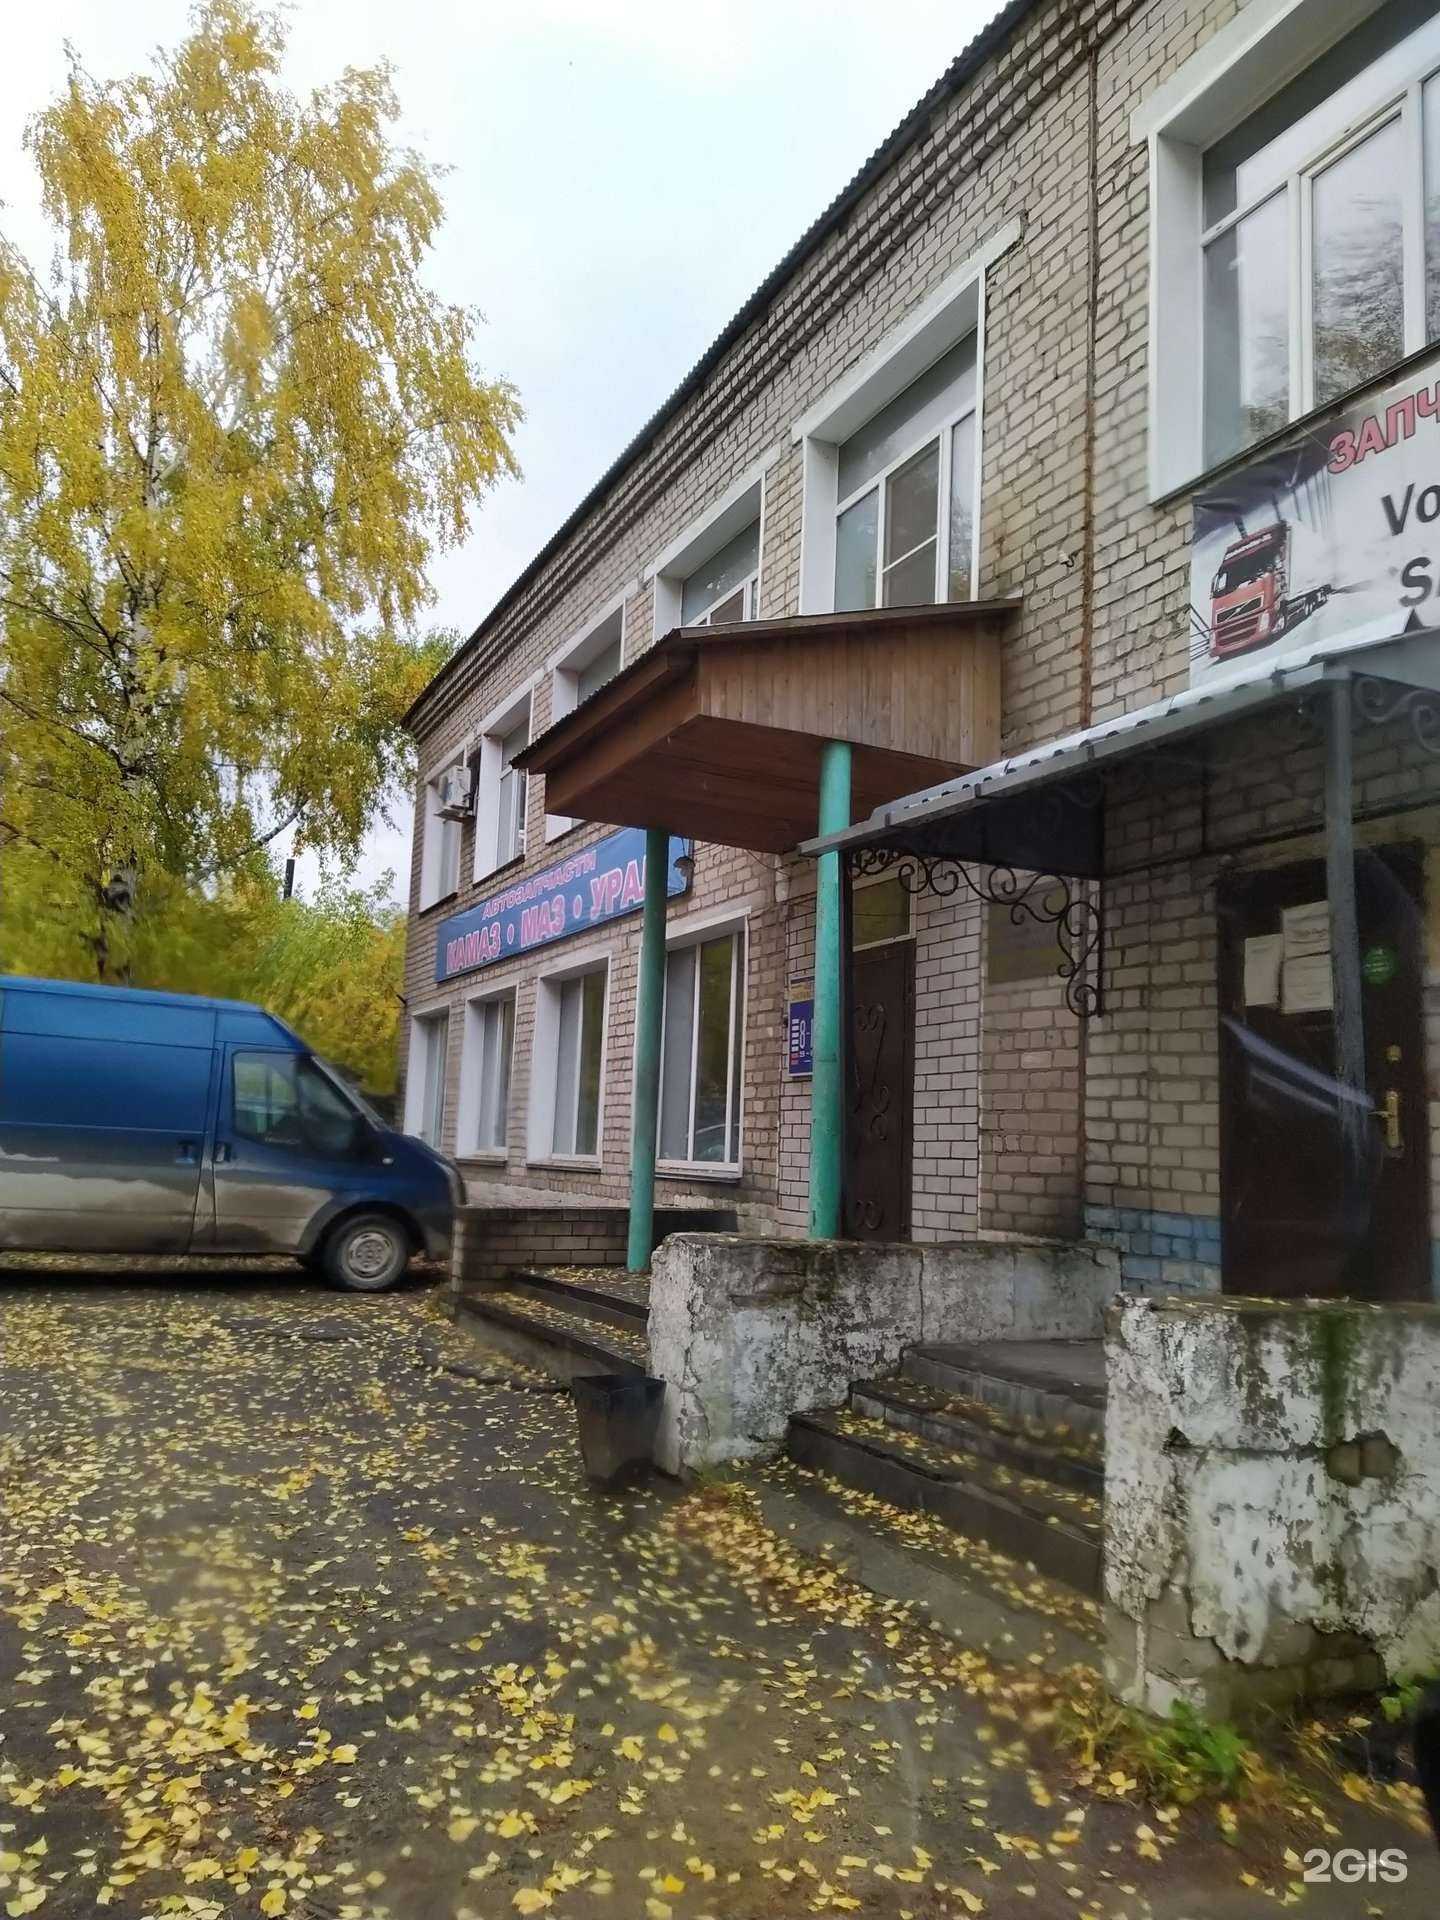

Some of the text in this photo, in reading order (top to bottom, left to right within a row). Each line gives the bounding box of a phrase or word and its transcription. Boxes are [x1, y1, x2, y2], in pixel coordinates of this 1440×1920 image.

[482, 850, 597, 920] АВТОЗАПЧАСТИ
[446, 921, 501, 974] КАМАЗ
[520, 894, 565, 948] МАЗ
